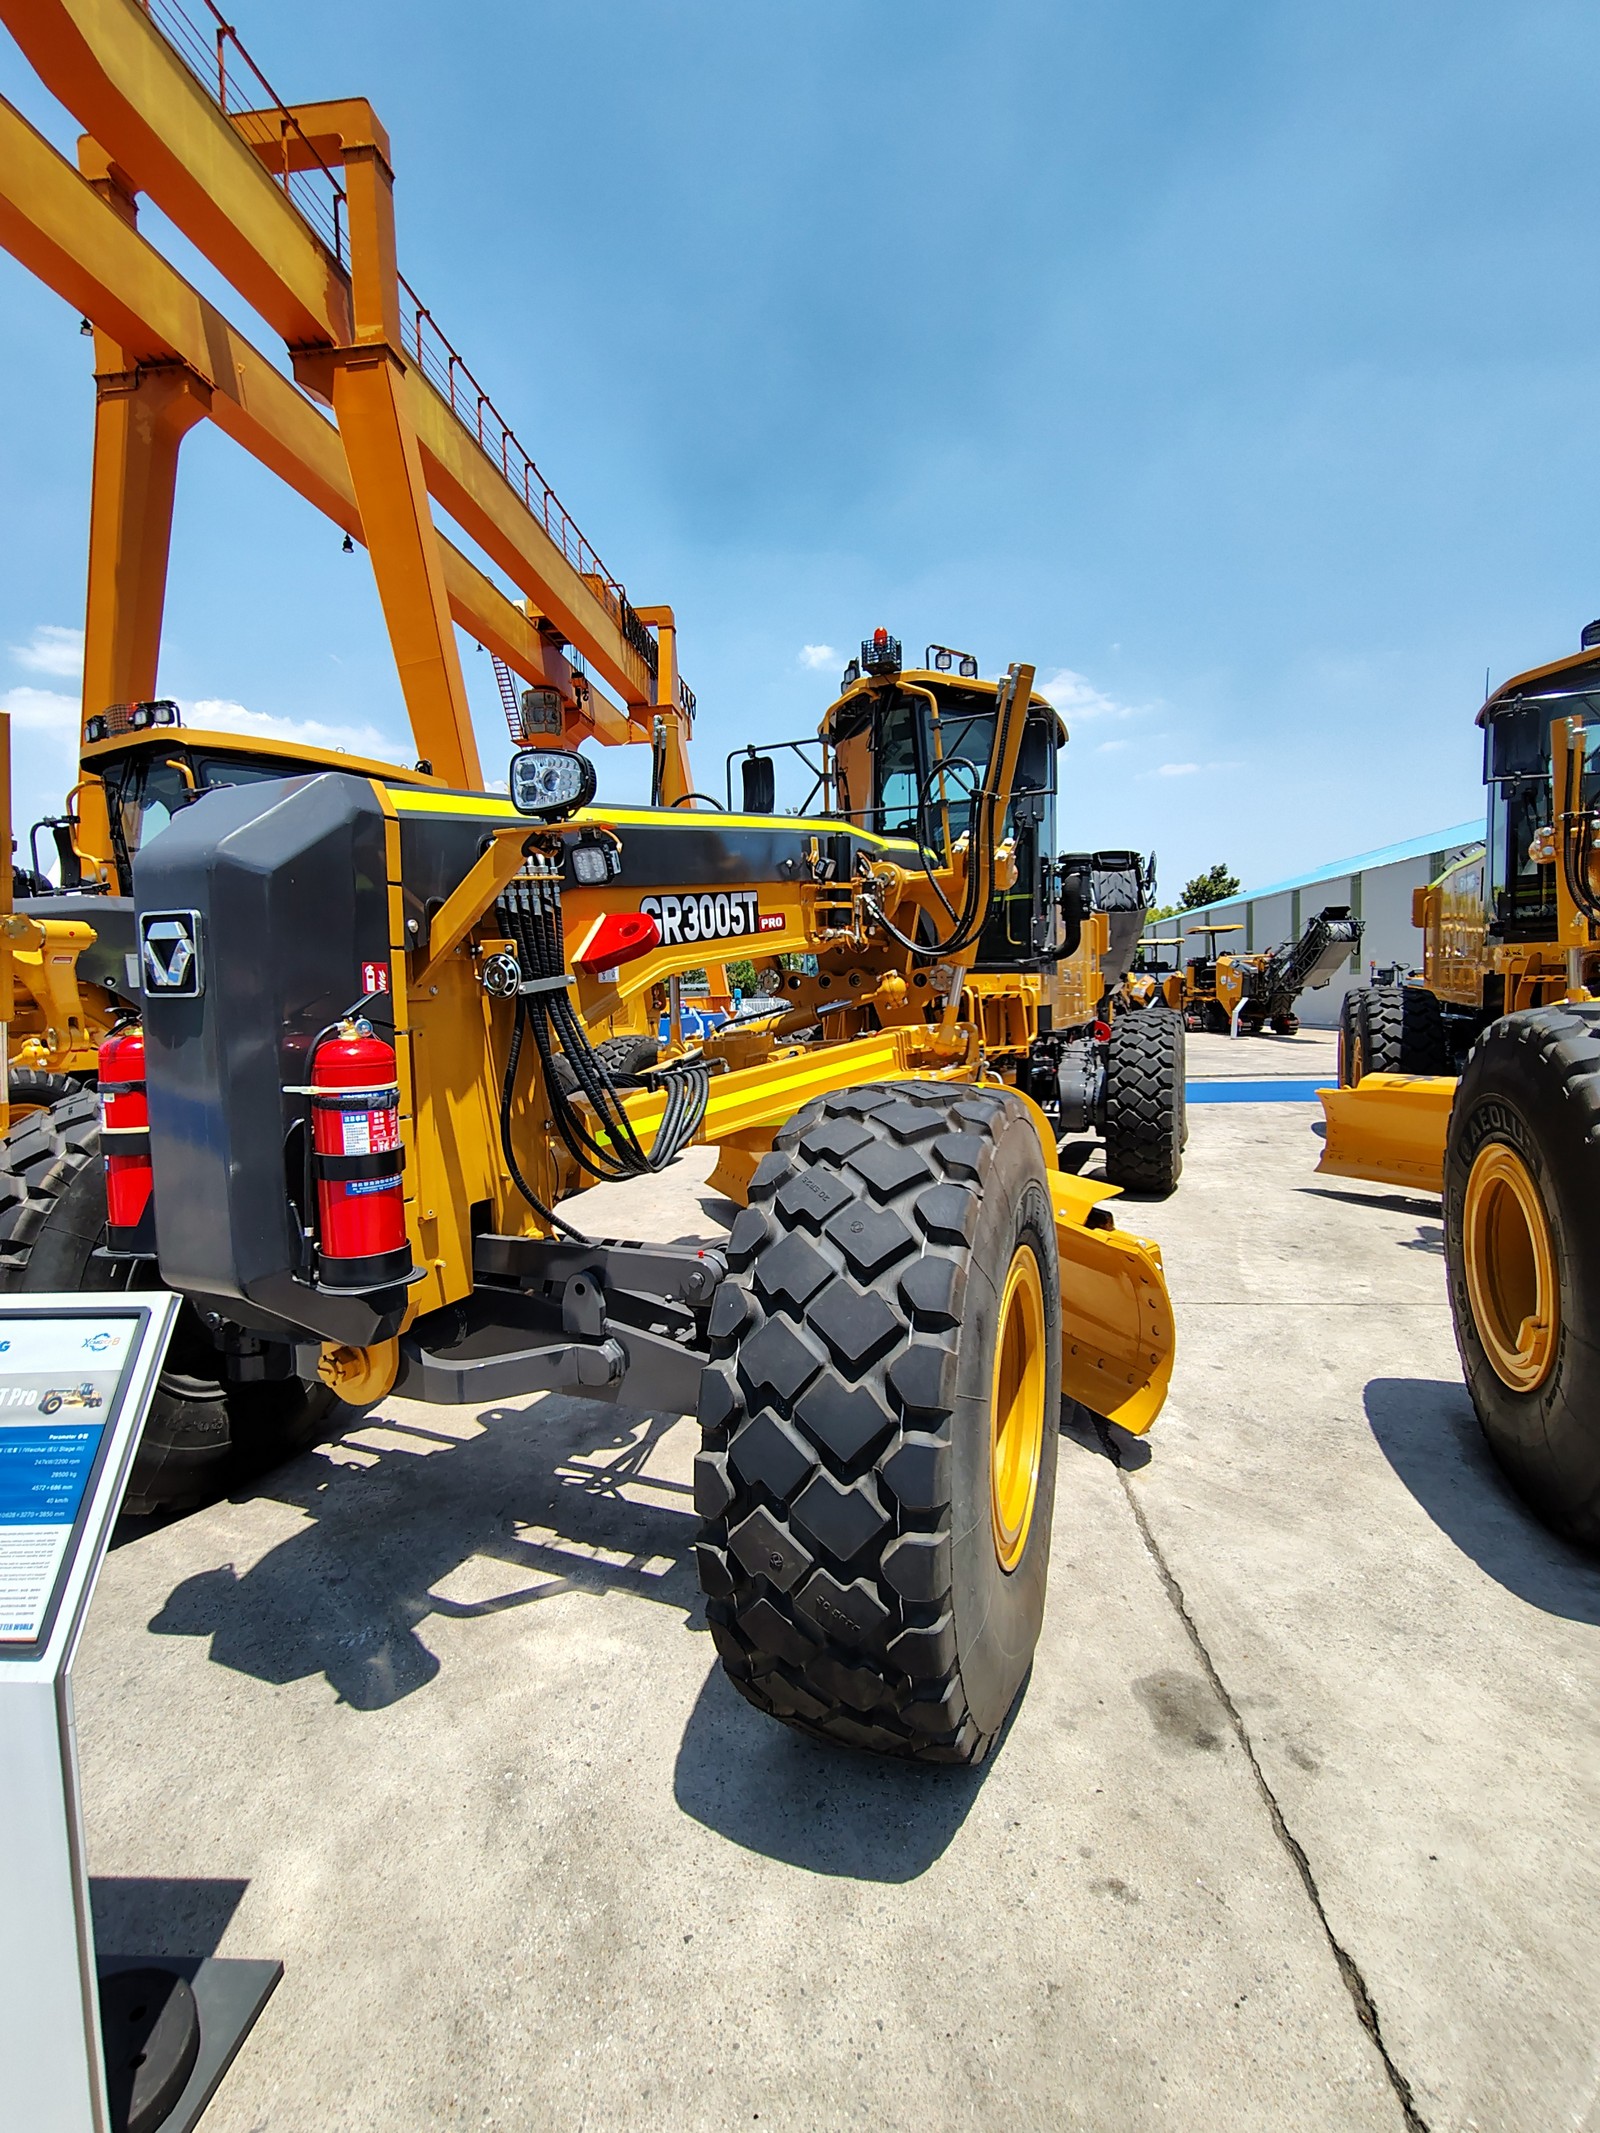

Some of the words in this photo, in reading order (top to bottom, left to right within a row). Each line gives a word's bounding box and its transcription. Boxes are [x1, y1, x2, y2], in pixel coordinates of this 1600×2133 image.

[640, 891, 758, 945] GR3005T
[761, 916, 783, 929] PRO
[7, 1388, 38, 1407] Pro
